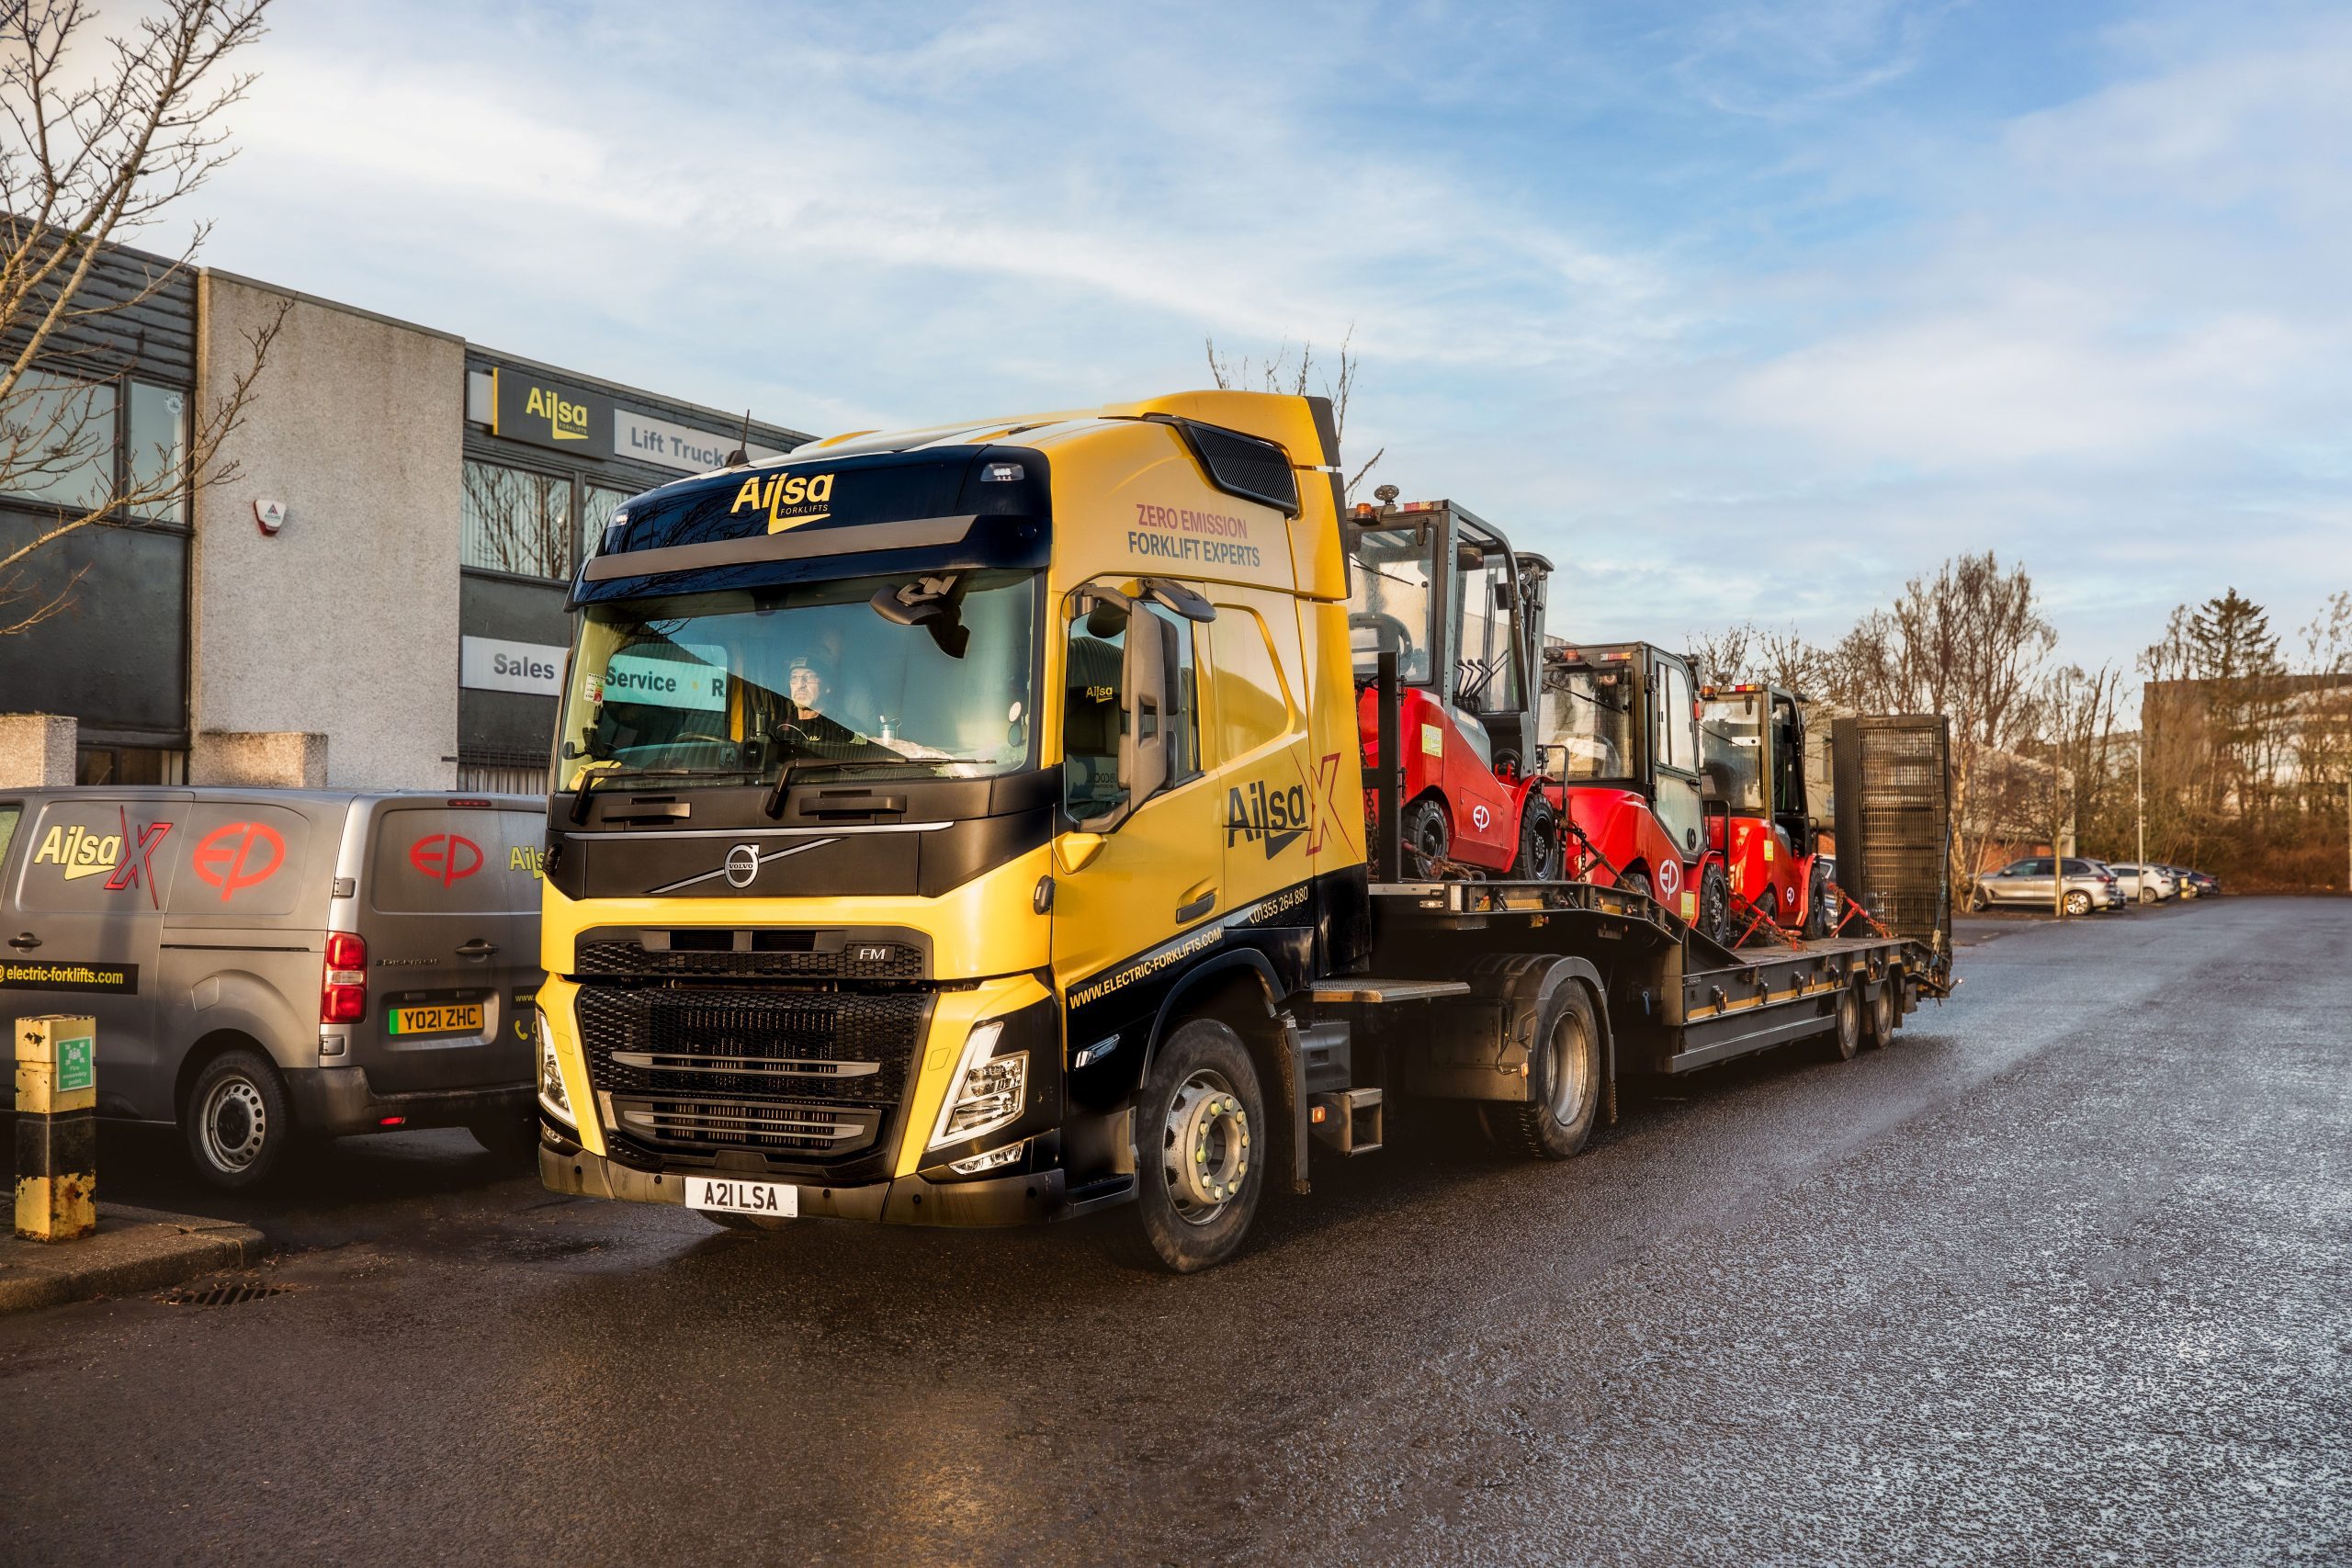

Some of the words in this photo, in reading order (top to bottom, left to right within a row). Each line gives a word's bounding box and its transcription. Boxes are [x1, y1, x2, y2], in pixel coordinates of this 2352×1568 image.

[525, 386, 589, 440] Ailsa
[559, 423, 588, 435] FORKLIFTS
[630, 426, 664, 454] Lift
[730, 472, 834, 536] Ailsa
[780, 503, 829, 515] FORKLIFTS
[1136, 503, 1178, 530] ZERO
[1180, 509, 1248, 539] EMISSION
[1127, 531, 1200, 560] FORKLIFT
[1203, 540, 1261, 568] EXPERTS
[492, 652, 555, 680] Sales
[606, 666, 677, 693] Service
[1085, 685, 1114, 704] Ailsa
[1227, 780, 1309, 861] Ailsa
[1473, 805, 1490, 833] EP
[33, 825, 122, 881] Ailsa
[192, 822, 286, 902] EP
[409, 833, 484, 890] EP
[509, 845, 546, 879] Ails
[1659, 859, 1679, 901] EP
[1253, 899, 1278, 923] 01355
[1278, 892, 1294, 912] 264
[1295, 885, 1308, 905] 880
[859, 948, 887, 960] FM
[1069, 926, 1223, 1010] WWW.ELECTRIC-FORKLIFTS.COM
[6, 964, 123, 985] electric-forklifts.com
[404, 1010, 442, 1031] YO21
[446, 1007, 477, 1028] ZHC
[704, 1181, 734, 1207] A21
[739, 1184, 778, 1212] LSA
